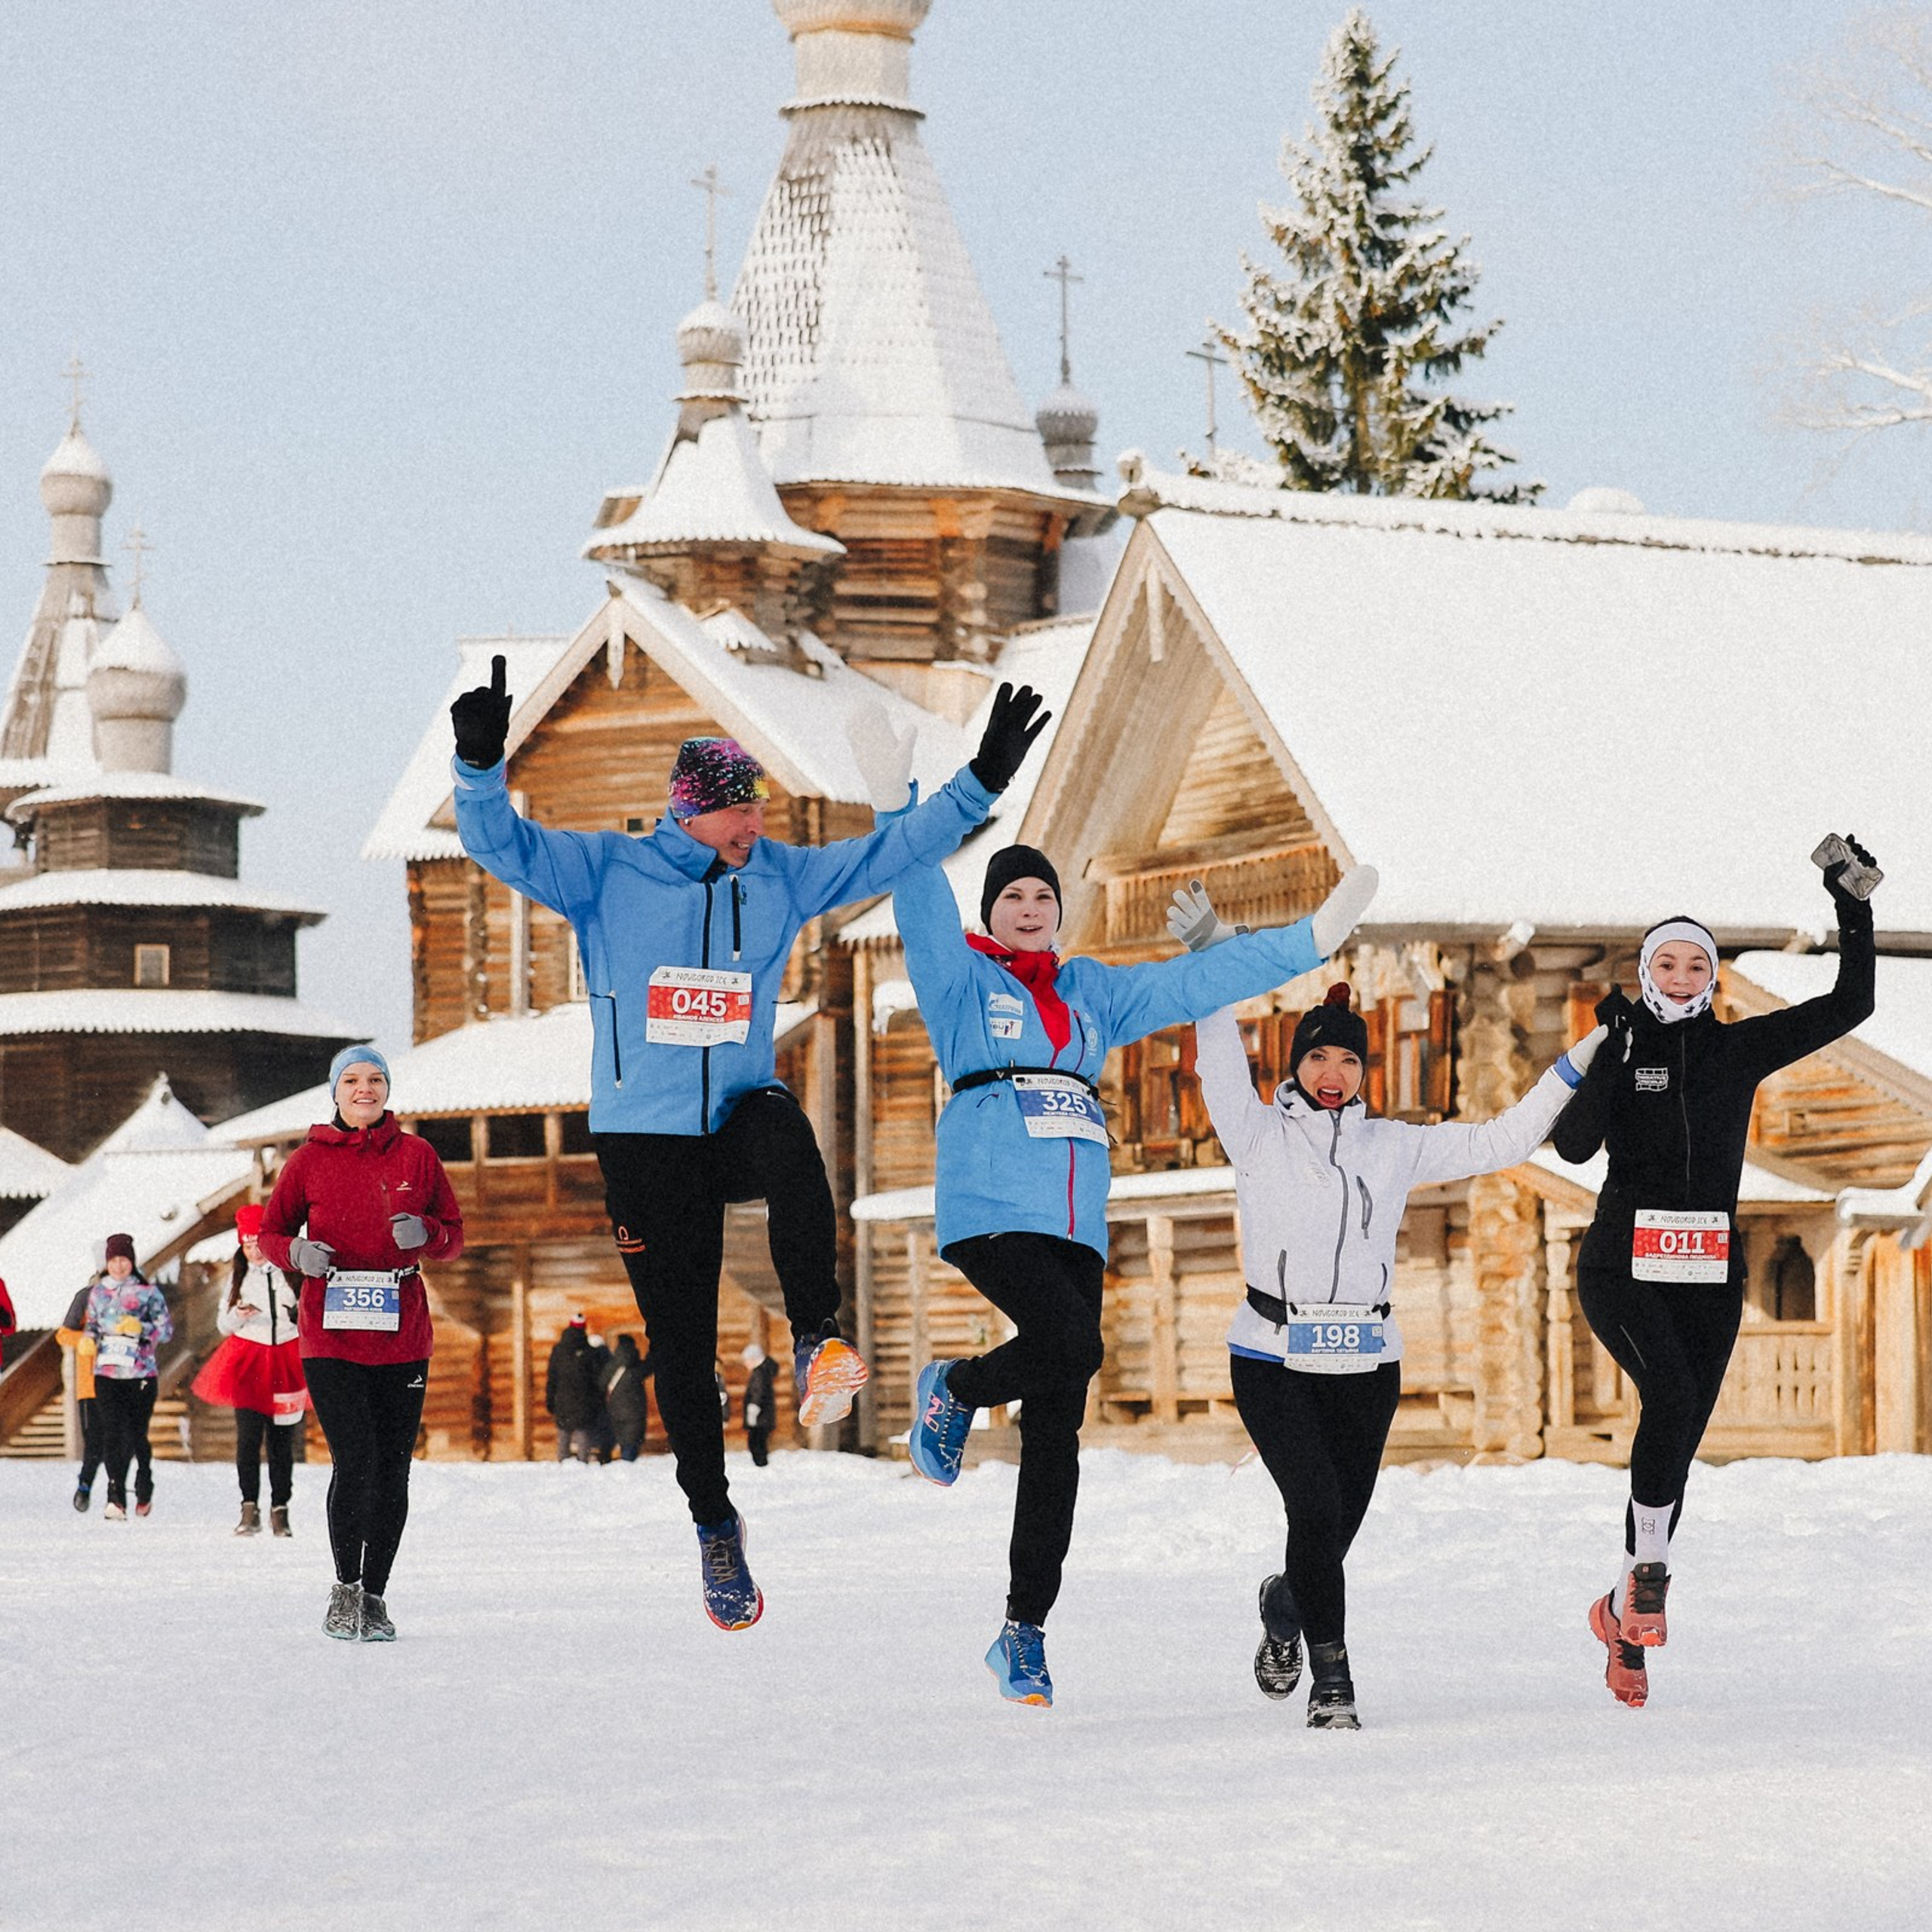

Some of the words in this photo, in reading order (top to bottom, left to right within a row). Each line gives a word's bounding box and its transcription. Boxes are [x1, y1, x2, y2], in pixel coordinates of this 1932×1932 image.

[672, 989, 727, 1017] 045
[1040, 1091, 1088, 1115] 325
[1660, 1231, 1705, 1254] 011
[343, 1288, 385, 1307] 356
[1312, 1324, 1360, 1348] 198
